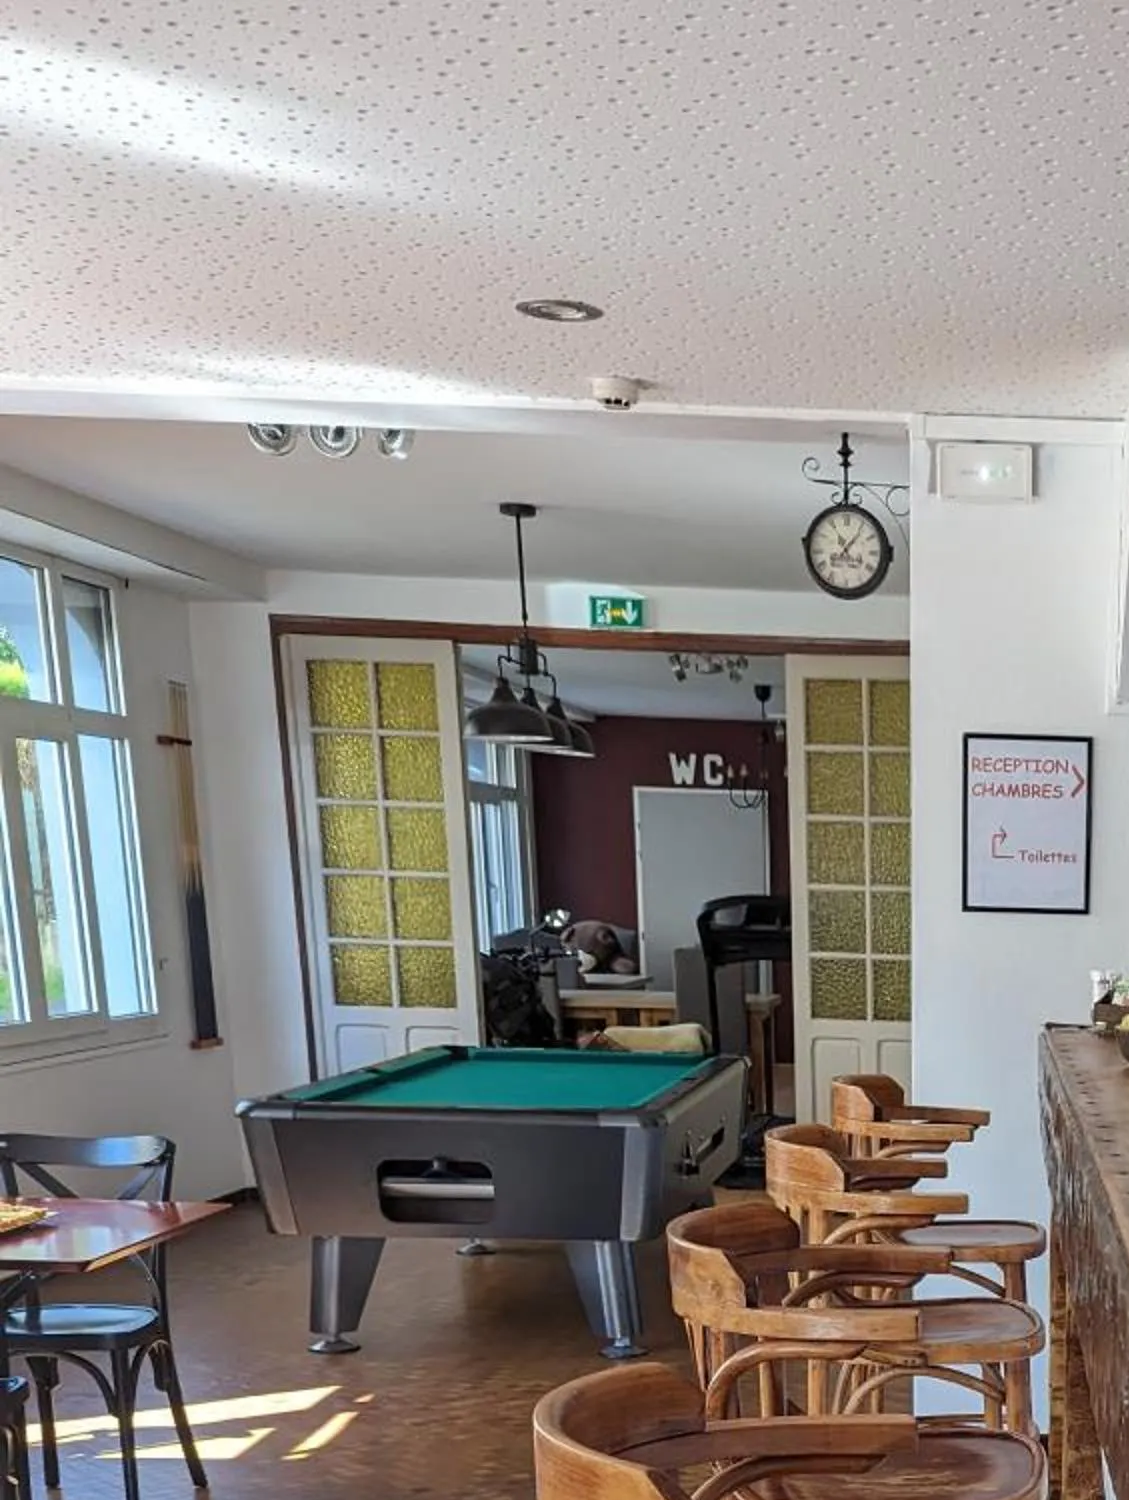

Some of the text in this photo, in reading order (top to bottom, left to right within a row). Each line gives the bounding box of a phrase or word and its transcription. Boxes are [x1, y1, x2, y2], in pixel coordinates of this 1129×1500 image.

[668, 752, 724, 786] WC
[971, 757, 1069, 774] RECEPTION
[971, 781, 1064, 799] CHAMBRES
[1018, 849, 1078, 864] Toilettes
